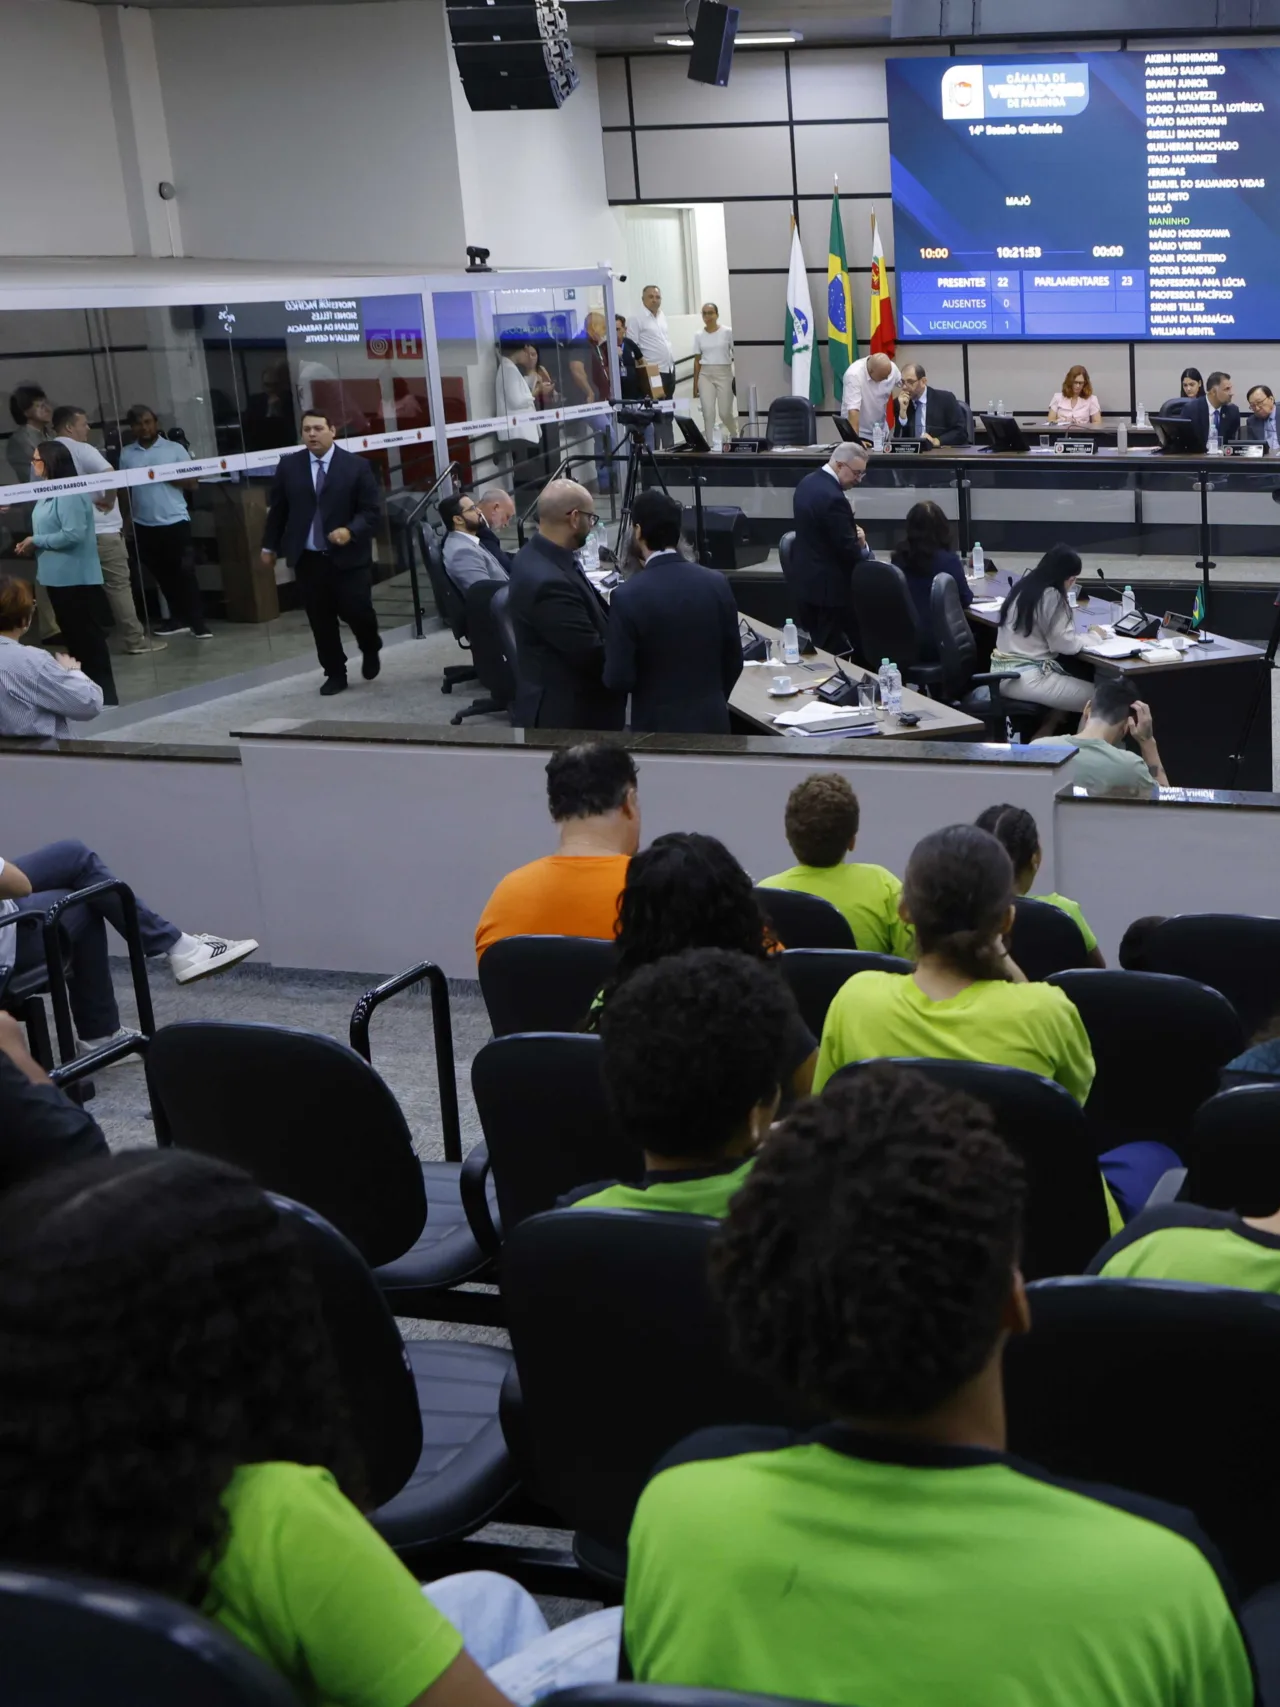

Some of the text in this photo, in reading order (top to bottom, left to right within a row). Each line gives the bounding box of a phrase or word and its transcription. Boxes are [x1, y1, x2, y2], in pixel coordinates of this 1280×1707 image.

[1145, 67, 1178, 76] ANGELO
[1006, 72, 1066, 84] CÂMARA DE
[1178, 78, 1208, 88] JUNIOR
[1146, 92, 1176, 102] DANIEL
[1007, 99, 1020, 108] DE
[1175, 104, 1210, 113] ALTAMIR
[1212, 104, 1225, 112] DA
[1226, 102, 1264, 112] LOTÉRICA
[1147, 115, 1227, 127] FLÁVIO MANTOVANI
[1147, 142, 1239, 151] GUILHERME MACHADO
[1180, 179, 1193, 188] DO
[1195, 179, 1238, 188] SALVANDO
[1240, 179, 1265, 187] VIDAS
[1006, 195, 1031, 206] MAJÔ
[1148, 192, 1189, 201] LUIZ NETO
[1148, 203, 1172, 213] MAJÔ
[1149, 217, 1190, 225] MANINHO
[1149, 228, 1176, 238] MÁRIO
[1149, 240, 1201, 250] MÁRIO VERRI
[920, 248, 949, 259] 10:00
[996, 247, 1042, 257] 10:21:53
[1092, 246, 1124, 257] 00:00
[1150, 266, 1216, 275] PASTOR SANDRO
[938, 278, 1008, 287] PRESENTES 22
[1034, 276, 1132, 287] PARLAMENTARES 23
[1150, 276, 1246, 287] PROFESSORA ANA LÚCIA
[1151, 291, 1195, 300] PROFESSOR
[942, 299, 1009, 308] AUSENTES 0
[1178, 302, 1204, 311] TELLES
[1179, 315, 1192, 323] DA
[1193, 313, 1234, 324] FARMÁCIA
[929, 321, 1009, 329] LICENCIADOS 1
[1151, 327, 1215, 336] WILLIAM GENTIL
[63, 481, 87, 490] BARBOSA
